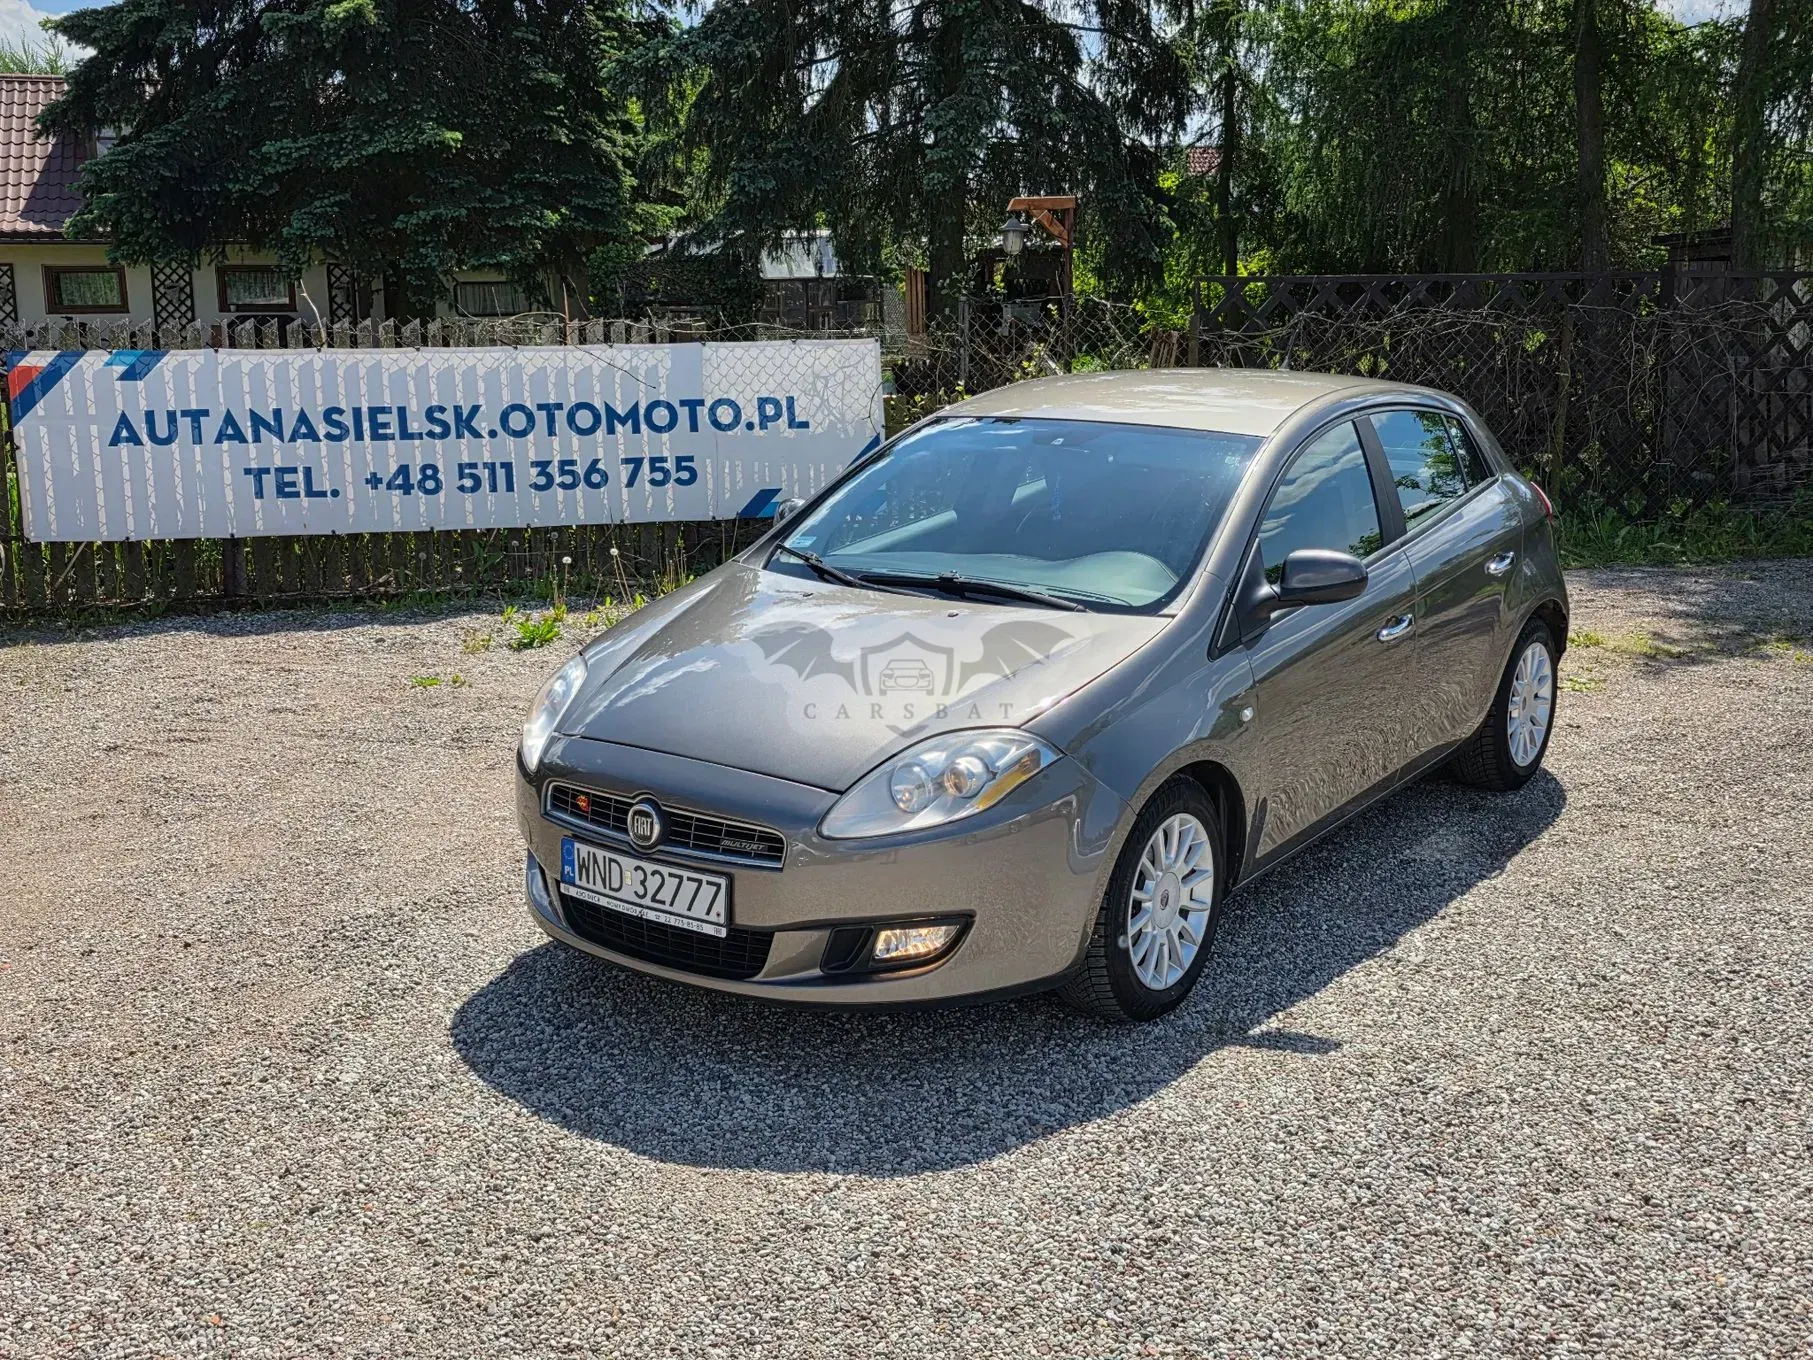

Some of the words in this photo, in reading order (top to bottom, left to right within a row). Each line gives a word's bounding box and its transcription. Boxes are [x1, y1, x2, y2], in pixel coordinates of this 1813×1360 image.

[109, 396, 810, 447] AUTANASIELSK.OTOMOTO.PL
[243, 466, 340, 498] TEL.
[364, 463, 443, 496] +48
[456, 461, 515, 493] 511
[529, 458, 609, 492] 356
[621, 455, 698, 488] 755
[634, 816, 653, 836] FIAT
[564, 865, 575, 877] PL
[576, 847, 623, 892] WND
[633, 865, 722, 916] 32777
